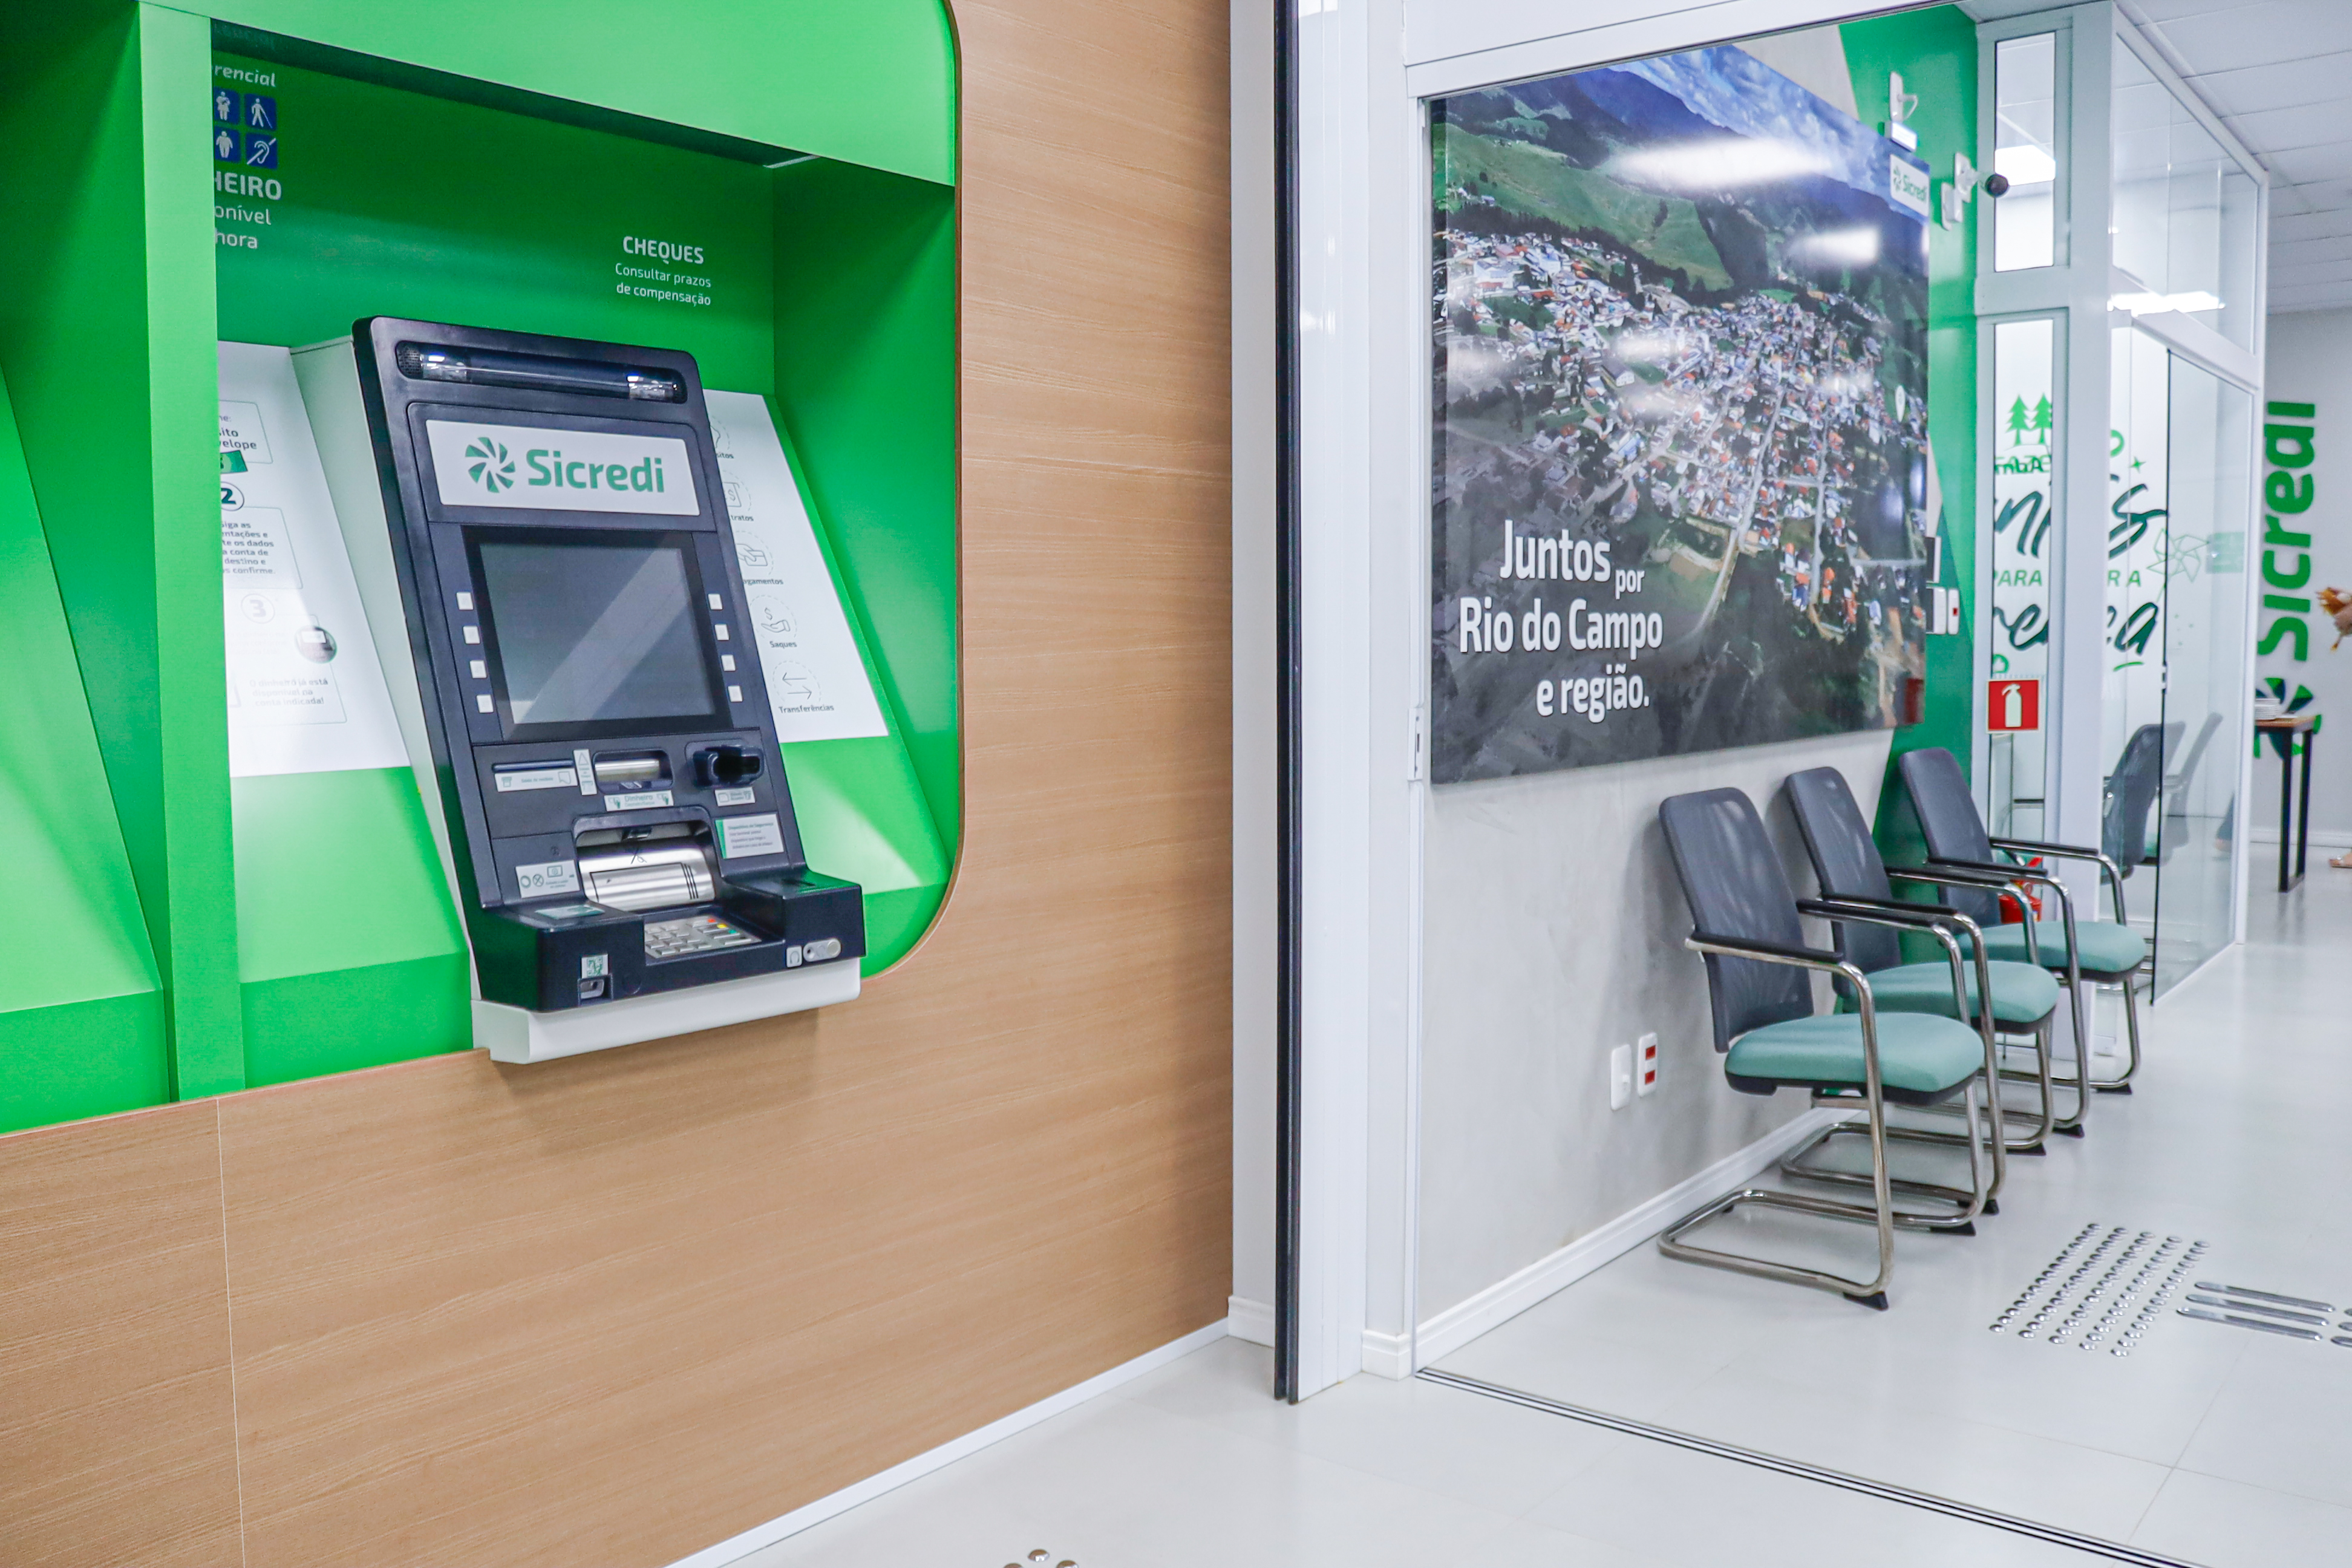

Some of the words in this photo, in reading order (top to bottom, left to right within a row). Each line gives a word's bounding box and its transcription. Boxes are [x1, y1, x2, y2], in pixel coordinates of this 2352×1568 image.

[214, 64, 276, 87] rencial
[215, 229, 258, 249] hora
[622, 235, 704, 265] CHEQUES
[615, 263, 671, 283] Consultar
[674, 273, 711, 288] prazos
[616, 282, 631, 295] de
[633, 286, 711, 307] compensação
[526, 448, 665, 493] Sicredi
[221, 488, 237, 505] 2
[1500, 518, 1611, 581] Juntos
[1615, 569, 1645, 599] por
[249, 599, 266, 617] 3
[1460, 596, 1514, 653] Rio
[1521, 598, 1561, 651] do
[1569, 598, 1663, 660] Campo
[769, 641, 797, 649] Saques
[309, 677, 328, 686] está
[1536, 679, 1554, 716] e
[1560, 663, 1650, 724] região.
[778, 704, 834, 713] Transferências
